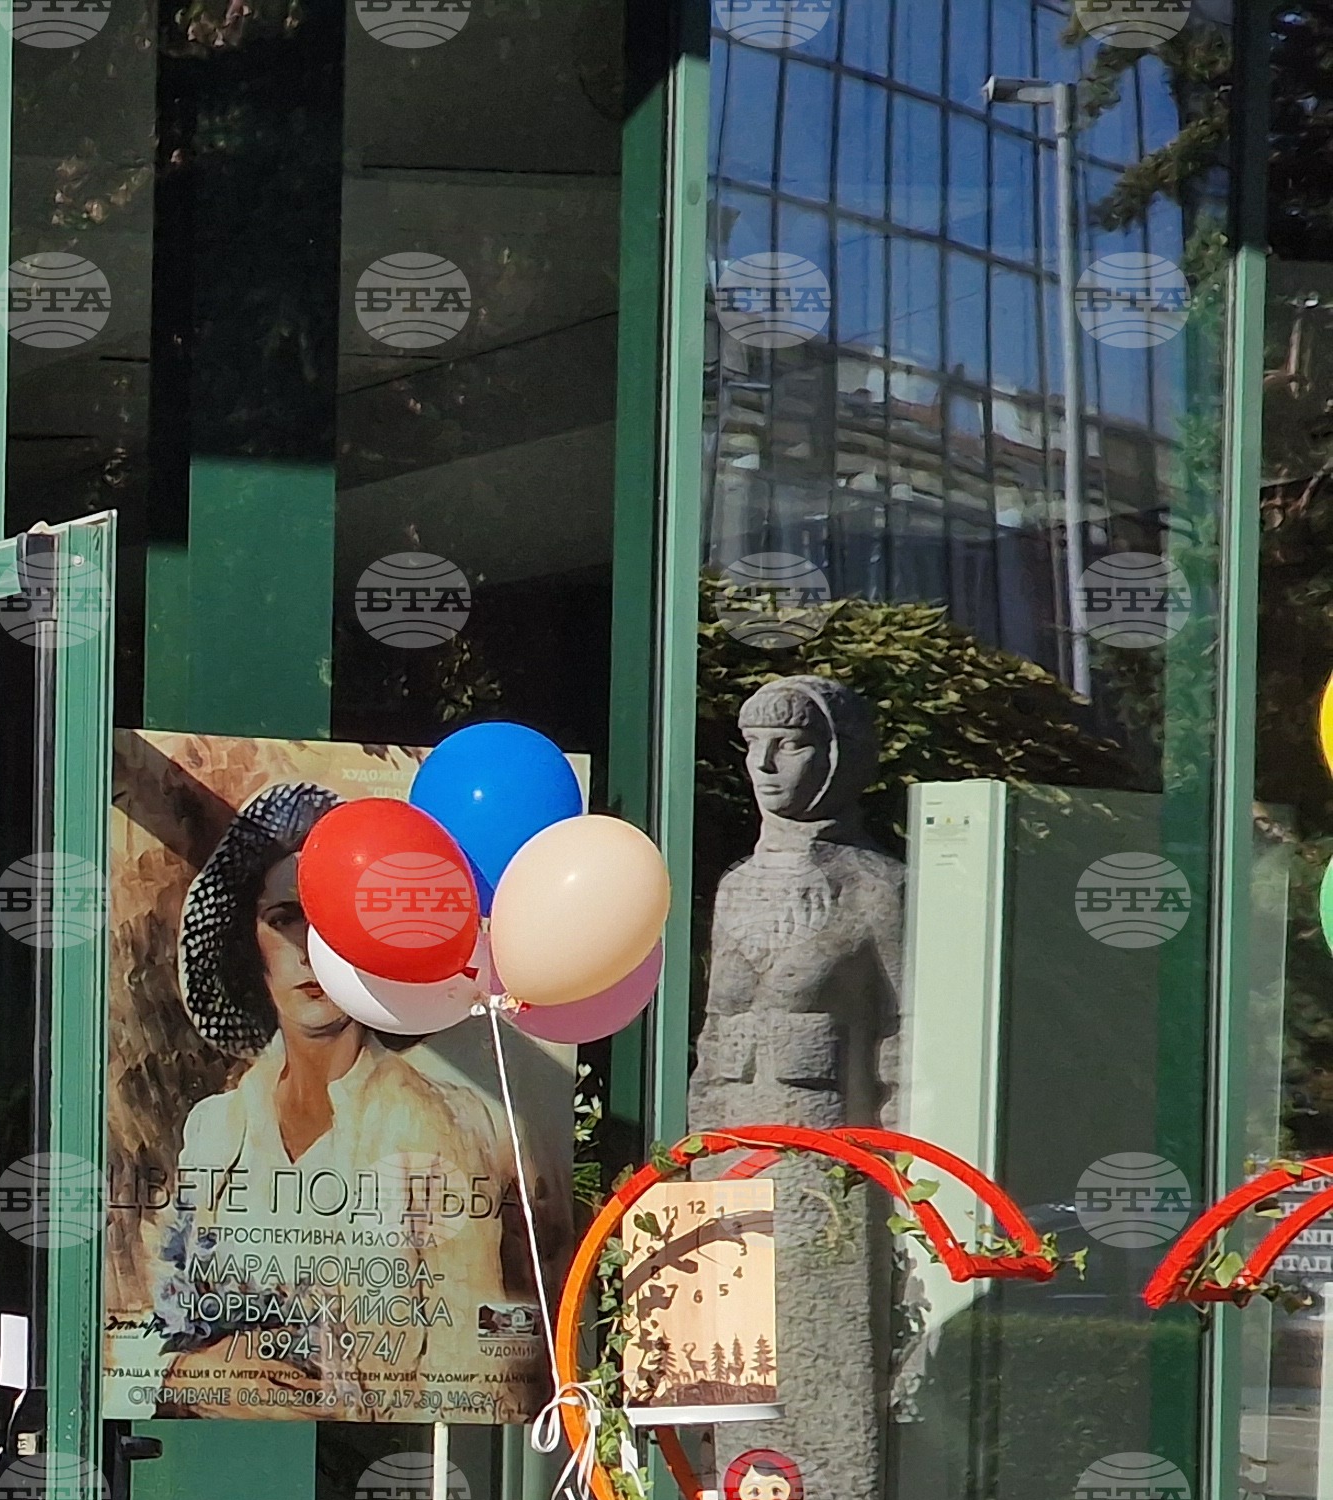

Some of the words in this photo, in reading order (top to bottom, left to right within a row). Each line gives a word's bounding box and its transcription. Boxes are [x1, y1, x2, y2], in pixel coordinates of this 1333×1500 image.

[107, 1166, 249, 1213] ЦВЕТЕ
[269, 1167, 383, 1224] ПОД
[400, 1172, 523, 1225] ДЪБА
[662, 1206, 679, 1221] 11
[687, 1200, 707, 1215] 12
[196, 1226, 346, 1246] РЕТРОСПЕКТИВНА
[351, 1229, 437, 1248] ИЗЛОЖБА
[189, 1251, 286, 1285] МАРА
[293, 1254, 445, 1289] НОНОВА-
[733, 1266, 743, 1279] 4
[666, 1284, 679, 1299] 7
[693, 1289, 703, 1304] 6
[719, 1283, 729, 1297] 5
[178, 1290, 453, 1328] ЧОРБАДЖИЙСКА
[225, 1330, 407, 1365] /1894-1974/
[213, 1368, 227, 1379] ОТ
[382, 1370, 417, 1383] МУЗЕЙ
[128, 1385, 230, 1405] ОТКРИВАНЕ
[361, 1391, 384, 1408] ОТ
[448, 1392, 495, 1409] ЧАСА
